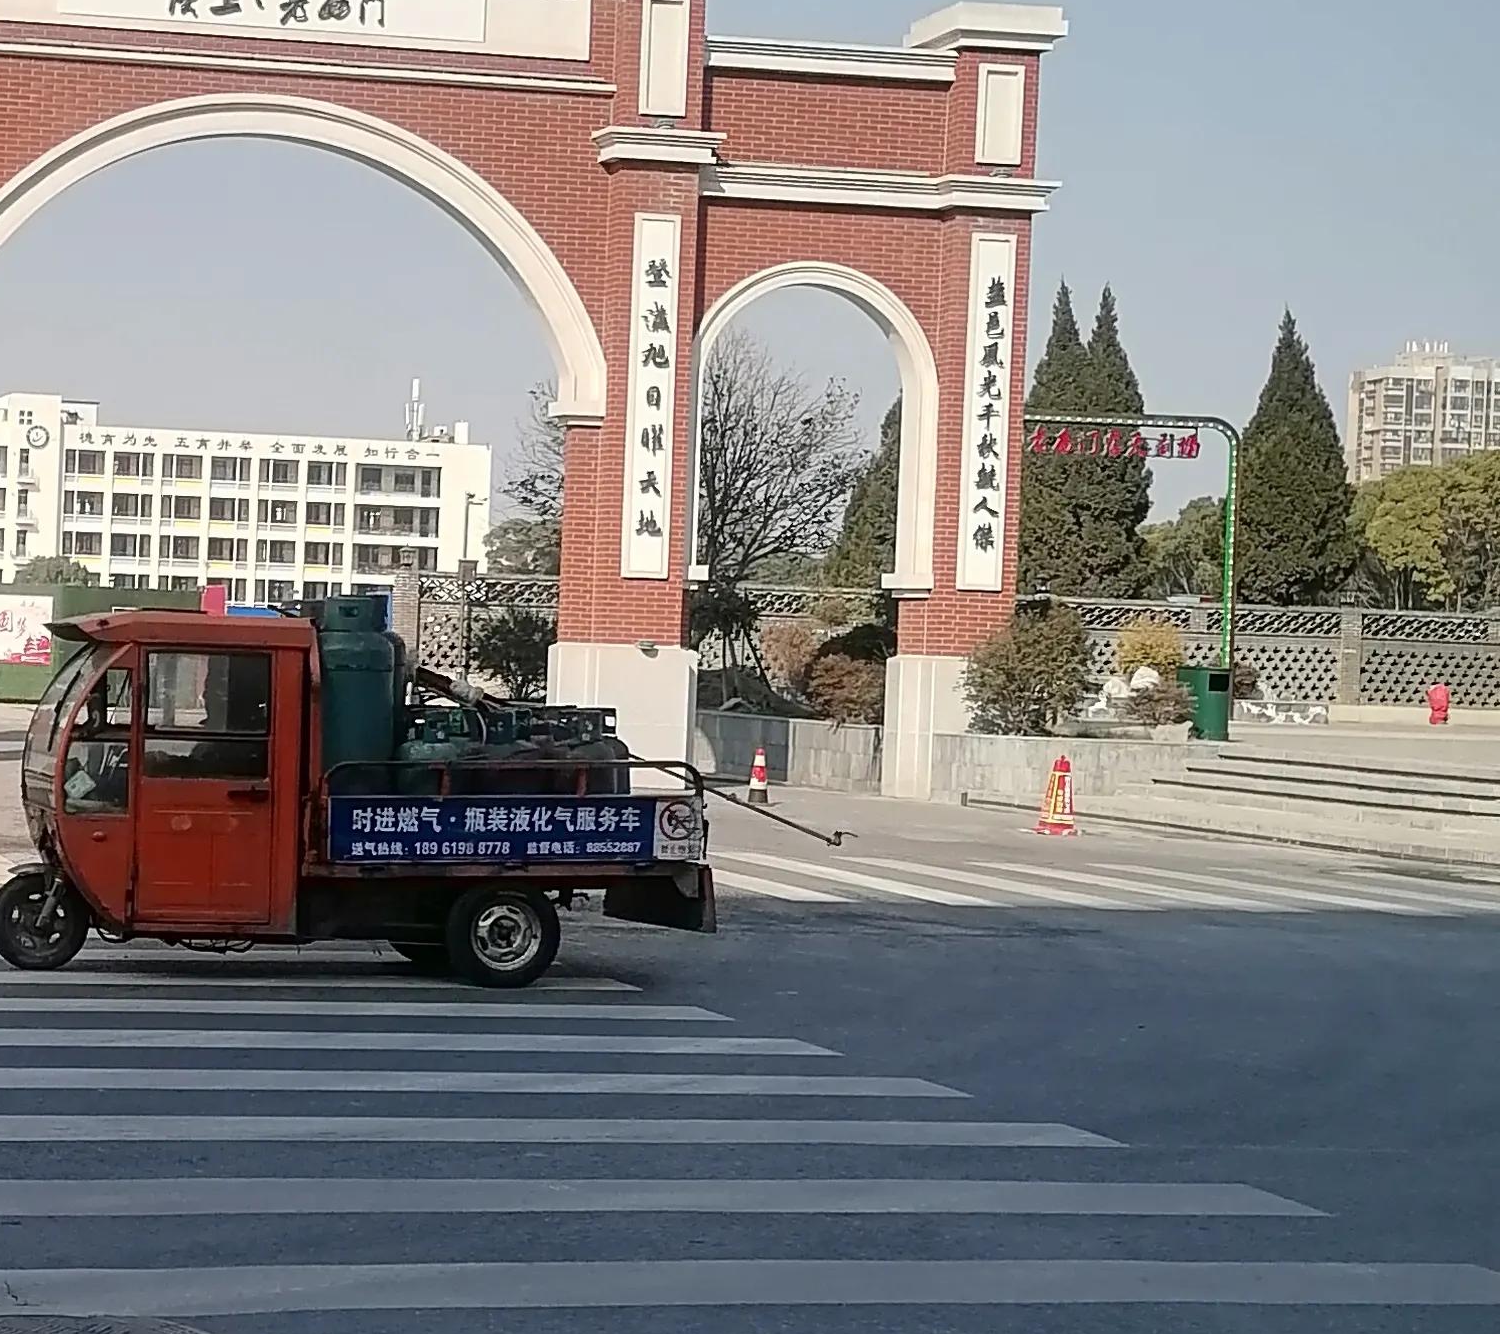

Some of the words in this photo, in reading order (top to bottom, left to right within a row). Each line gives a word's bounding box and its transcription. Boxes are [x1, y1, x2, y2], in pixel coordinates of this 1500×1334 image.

[269, 441, 348, 457] 全面发展
[364, 446, 440, 461] 知行合一
